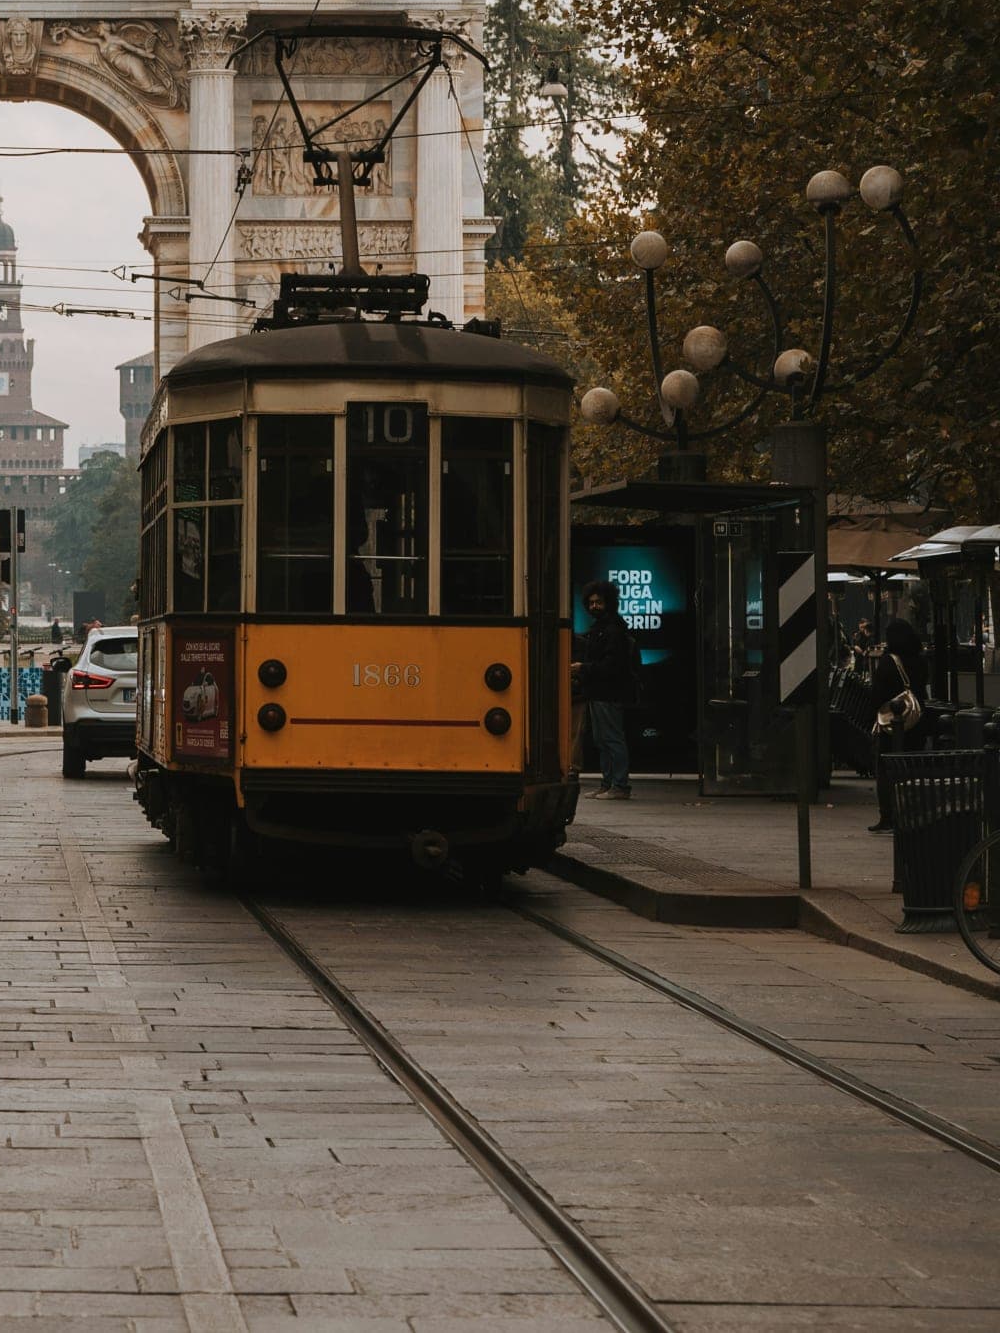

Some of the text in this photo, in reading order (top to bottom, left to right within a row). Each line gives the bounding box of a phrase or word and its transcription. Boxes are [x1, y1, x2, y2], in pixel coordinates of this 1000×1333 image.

[366, 406, 413, 443] 10
[608, 570, 652, 584] FORD
[618, 585, 653, 599] UGA
[617, 600, 663, 614] UG-IN
[622, 615, 662, 630] BRID
[353, 663, 420, 687] 1866
